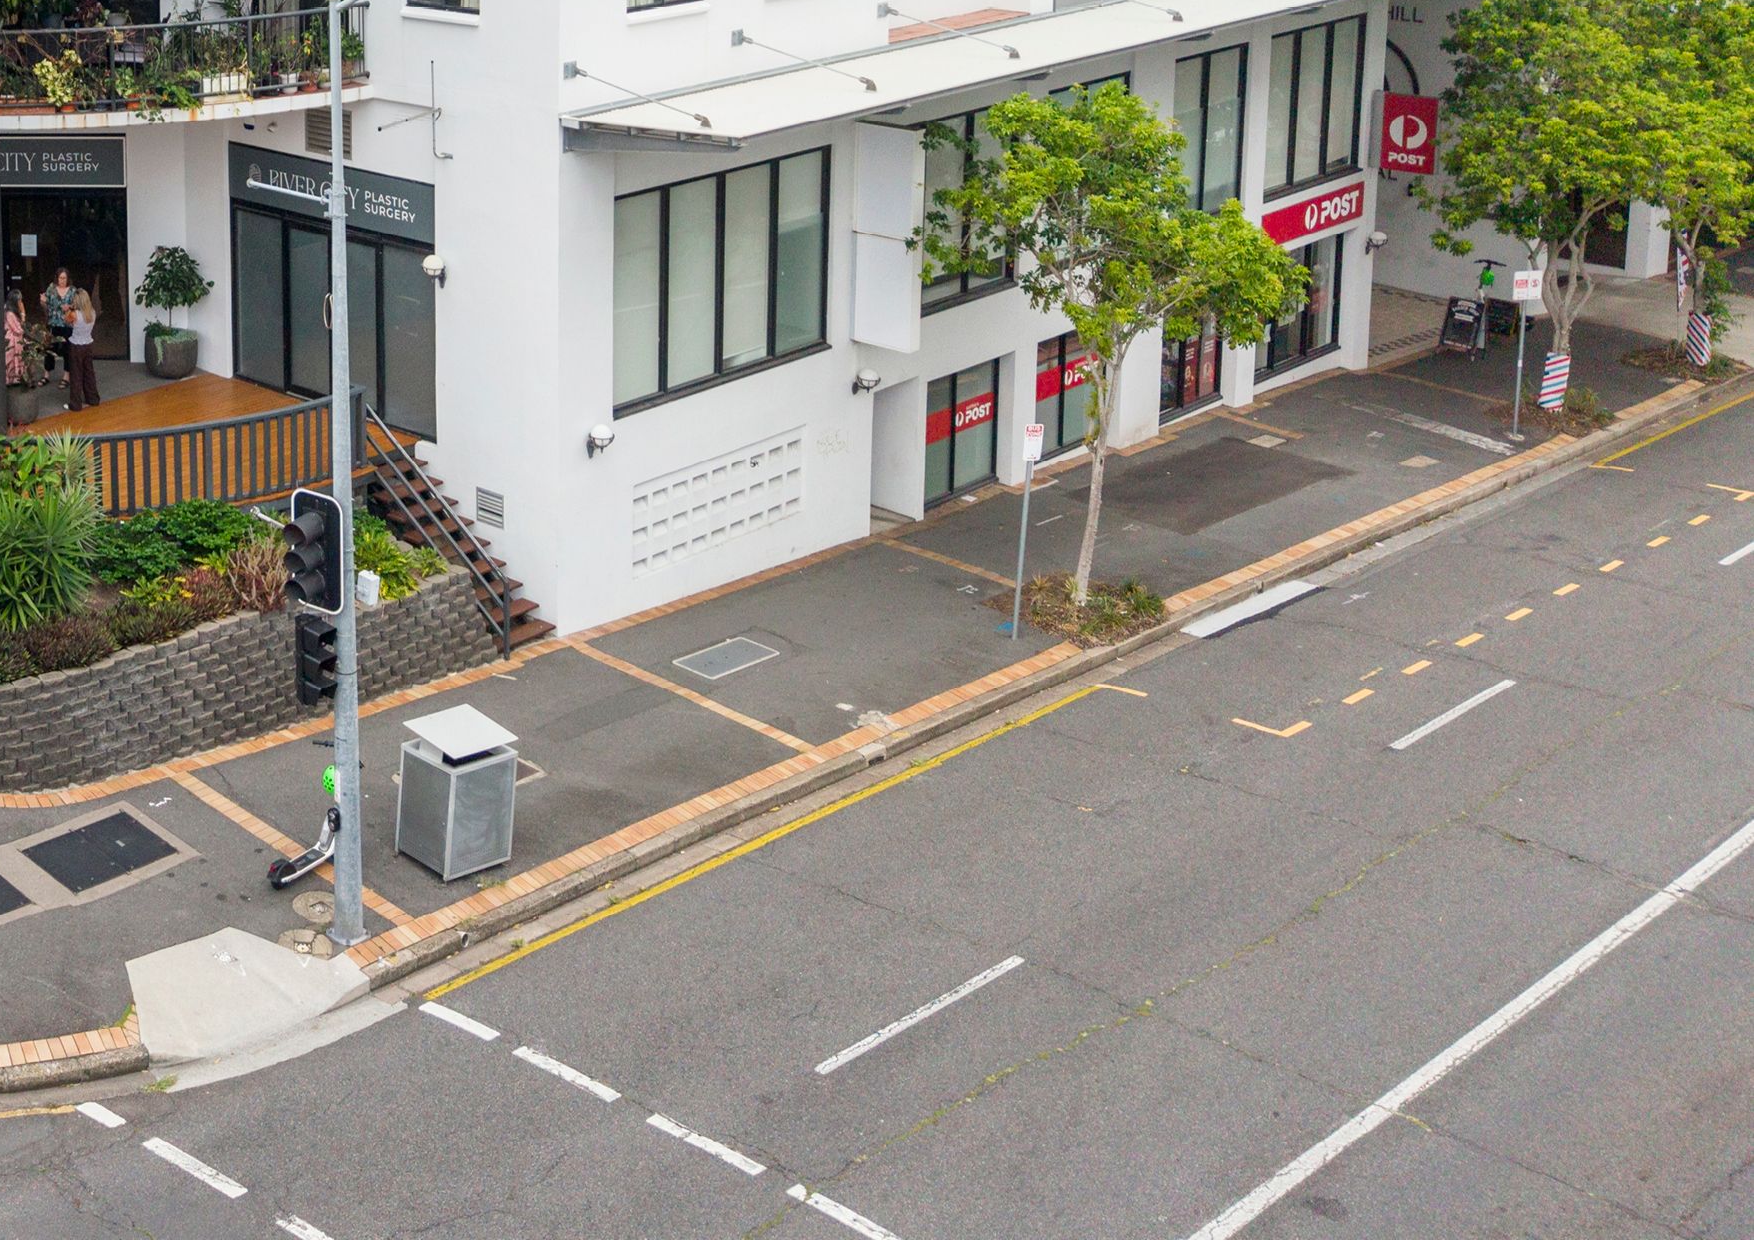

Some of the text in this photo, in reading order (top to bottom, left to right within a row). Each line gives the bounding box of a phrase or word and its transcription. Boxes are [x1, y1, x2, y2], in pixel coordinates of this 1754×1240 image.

[42, 152, 92, 162] PLASTIC
[42, 162, 100, 172] SURGERY
[1388, 151, 1426, 166] POST
[364, 190, 409, 210] PLASTIC
[1320, 190, 1359, 225] POST
[364, 202, 416, 223] SURGERY
[965, 402, 992, 424] POST
